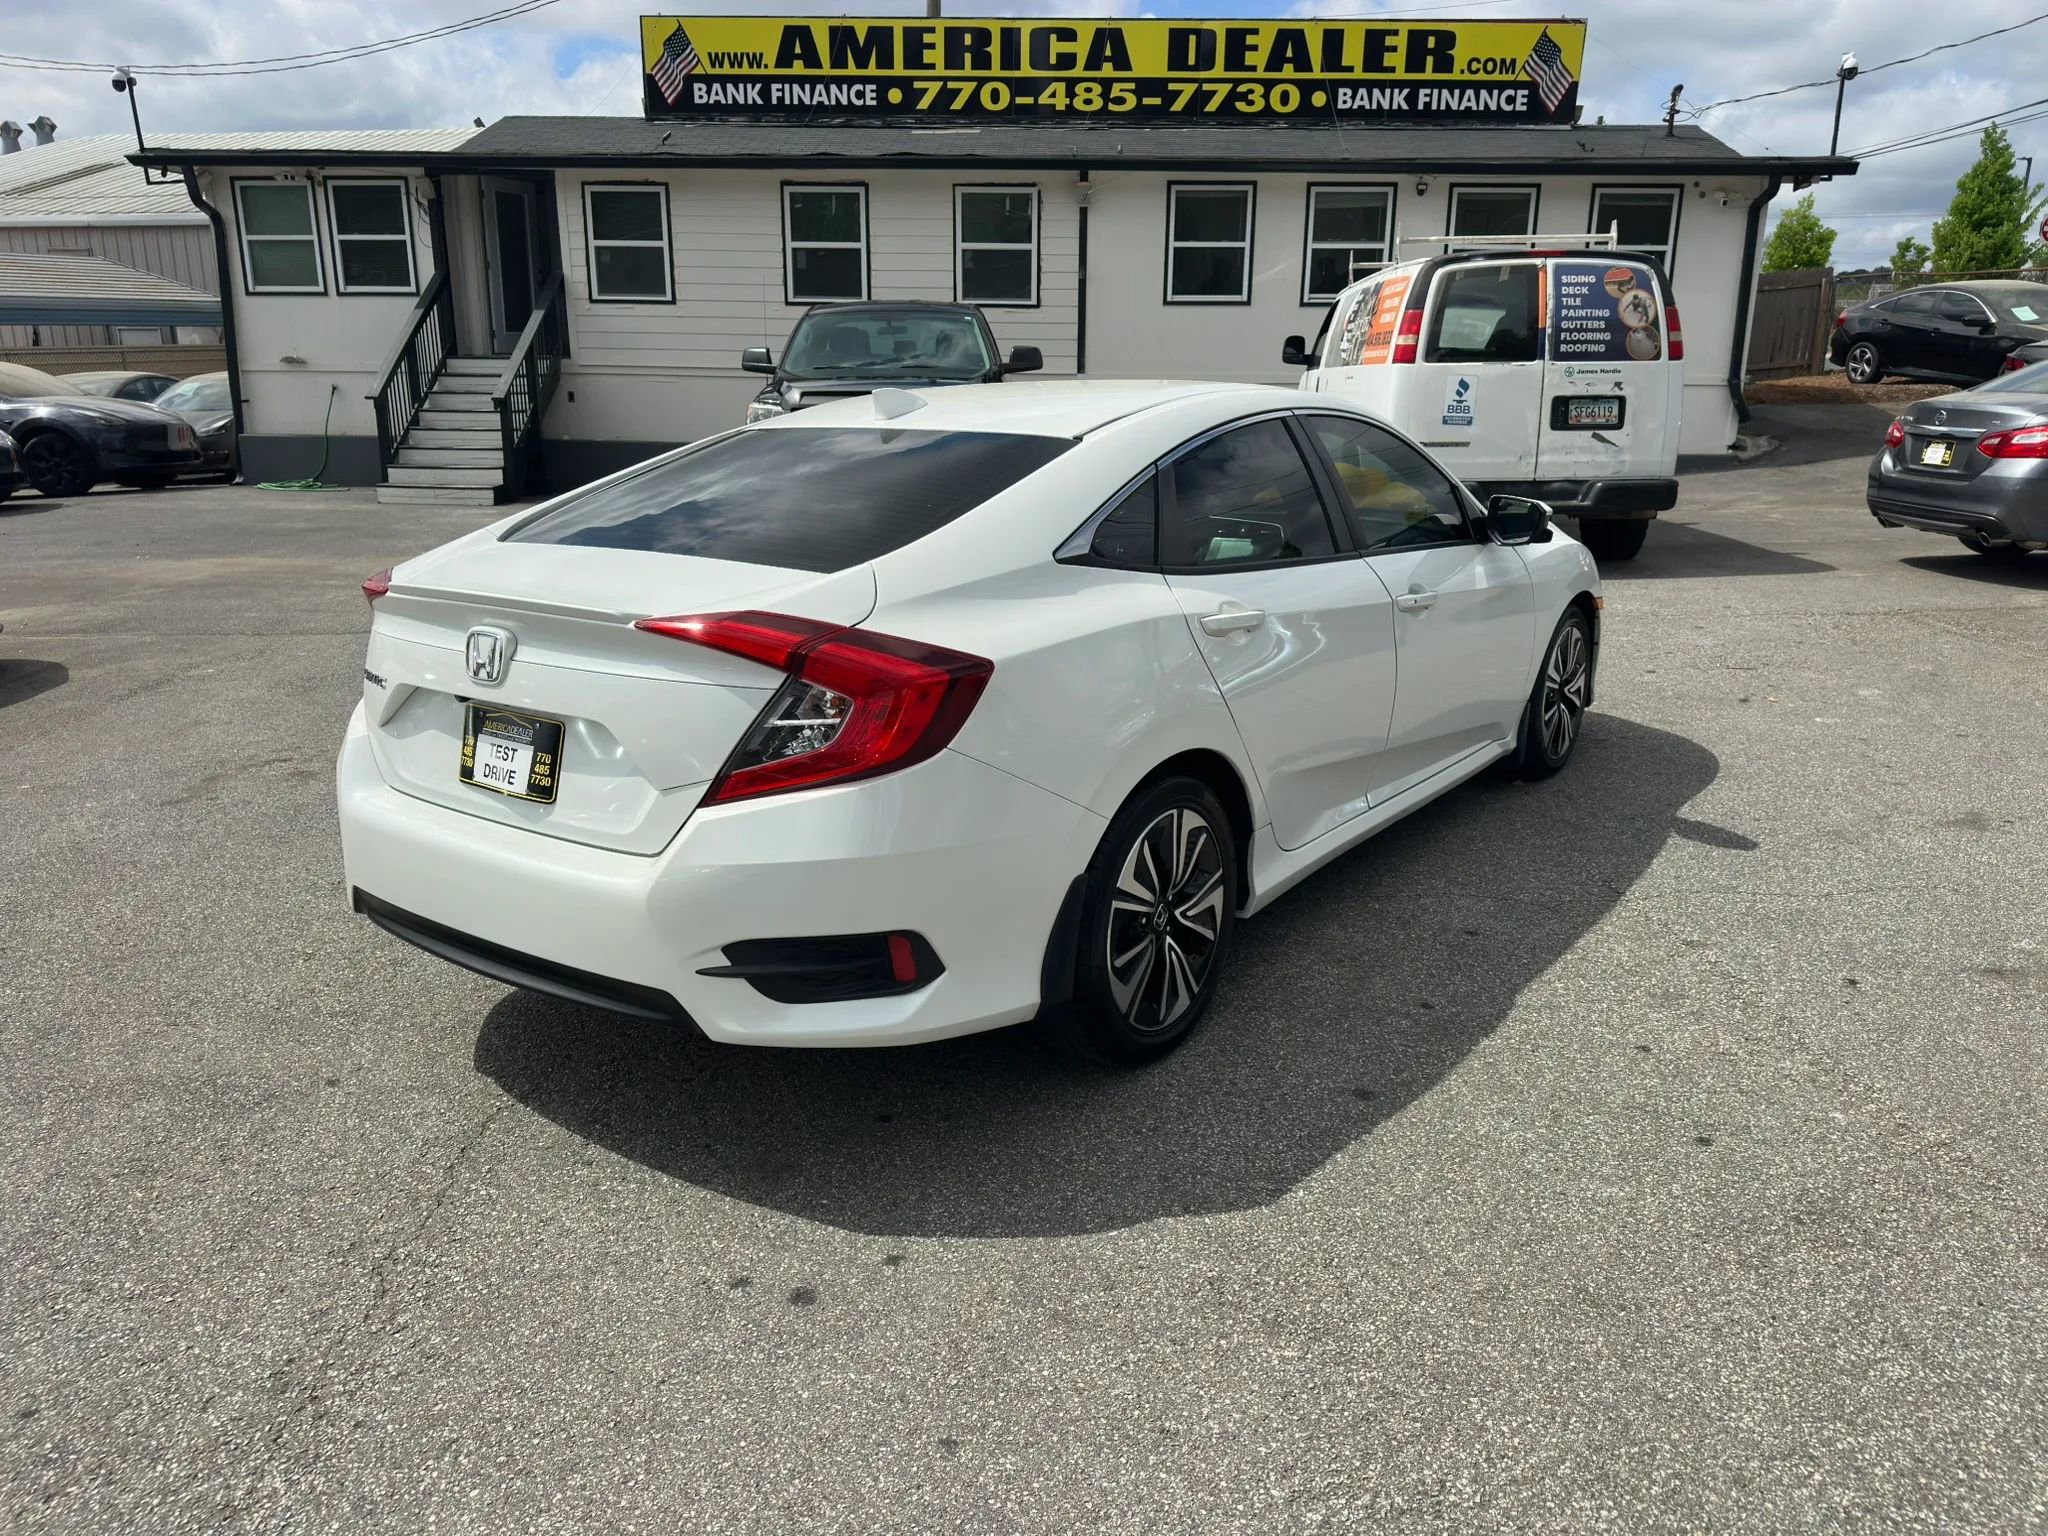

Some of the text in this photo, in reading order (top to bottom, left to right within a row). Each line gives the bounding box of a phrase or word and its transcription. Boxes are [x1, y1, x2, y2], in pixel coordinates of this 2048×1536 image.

[774, 25, 1133, 71] AMERICA
[693, 81, 1528, 112] BANK FINANCE 770-485-7730 BANK FINANCE
[1561, 275, 1596, 283] SIDING
[1561, 286, 1589, 294] DECK
[1561, 297, 1582, 306] TILE
[1561, 309, 1610, 317] PAINTING
[1561, 320, 1606, 329] GUTTERS
[1560, 332, 1611, 341] FLOORING
[1560, 344, 1606, 352] ROOFING
[1447, 404, 1471, 414] BBB
[464, 745, 473, 757] 485
[490, 742, 518, 763] TEST
[537, 752, 552, 764] 770
[483, 763, 517, 785] DRIVE
[534, 763, 550, 776] 485
[530, 774, 552, 788] 7730
